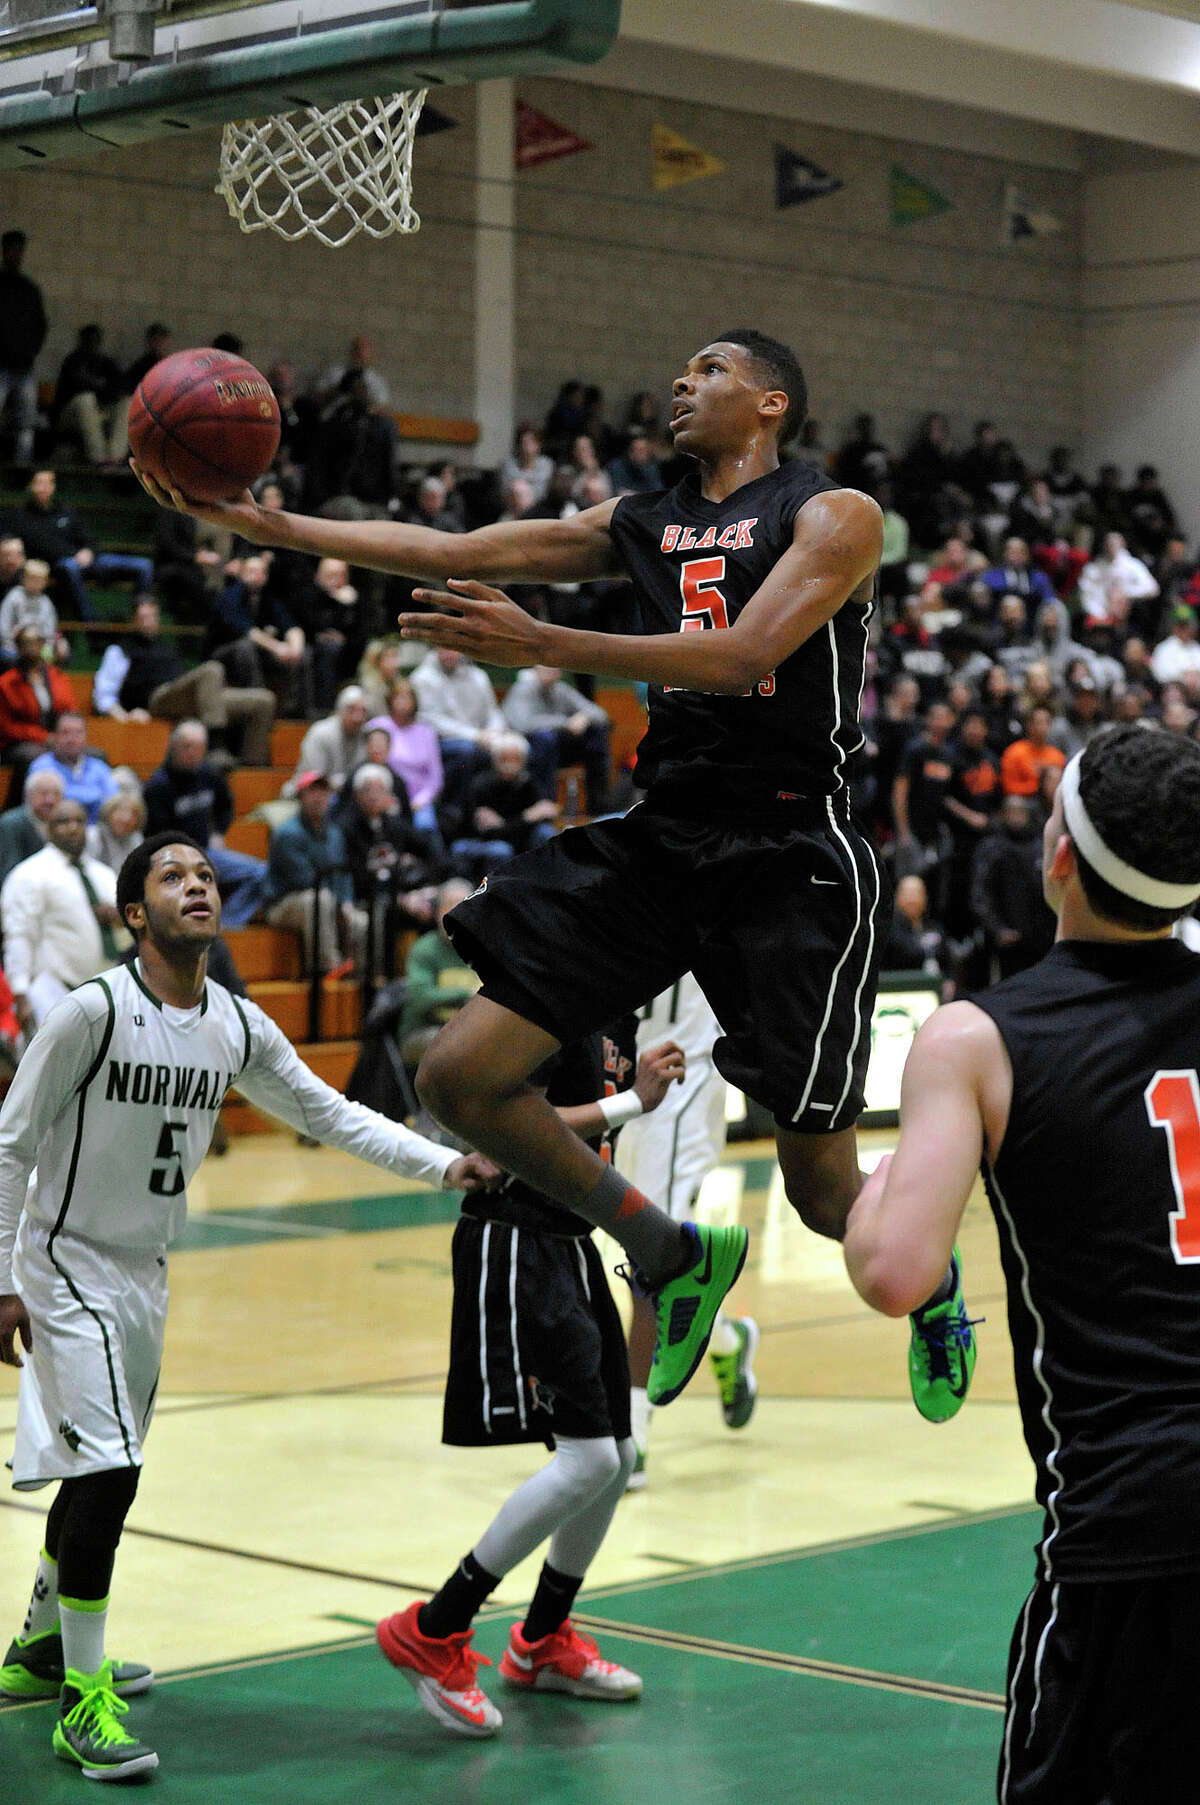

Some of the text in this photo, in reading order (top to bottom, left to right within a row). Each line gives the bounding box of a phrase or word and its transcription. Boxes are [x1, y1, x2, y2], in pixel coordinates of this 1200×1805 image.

[661, 518, 758, 553] BLACK
[680, 556, 729, 633] 5
[149, 1122, 188, 1196] 5
[1144, 1069, 1200, 1264] 1
